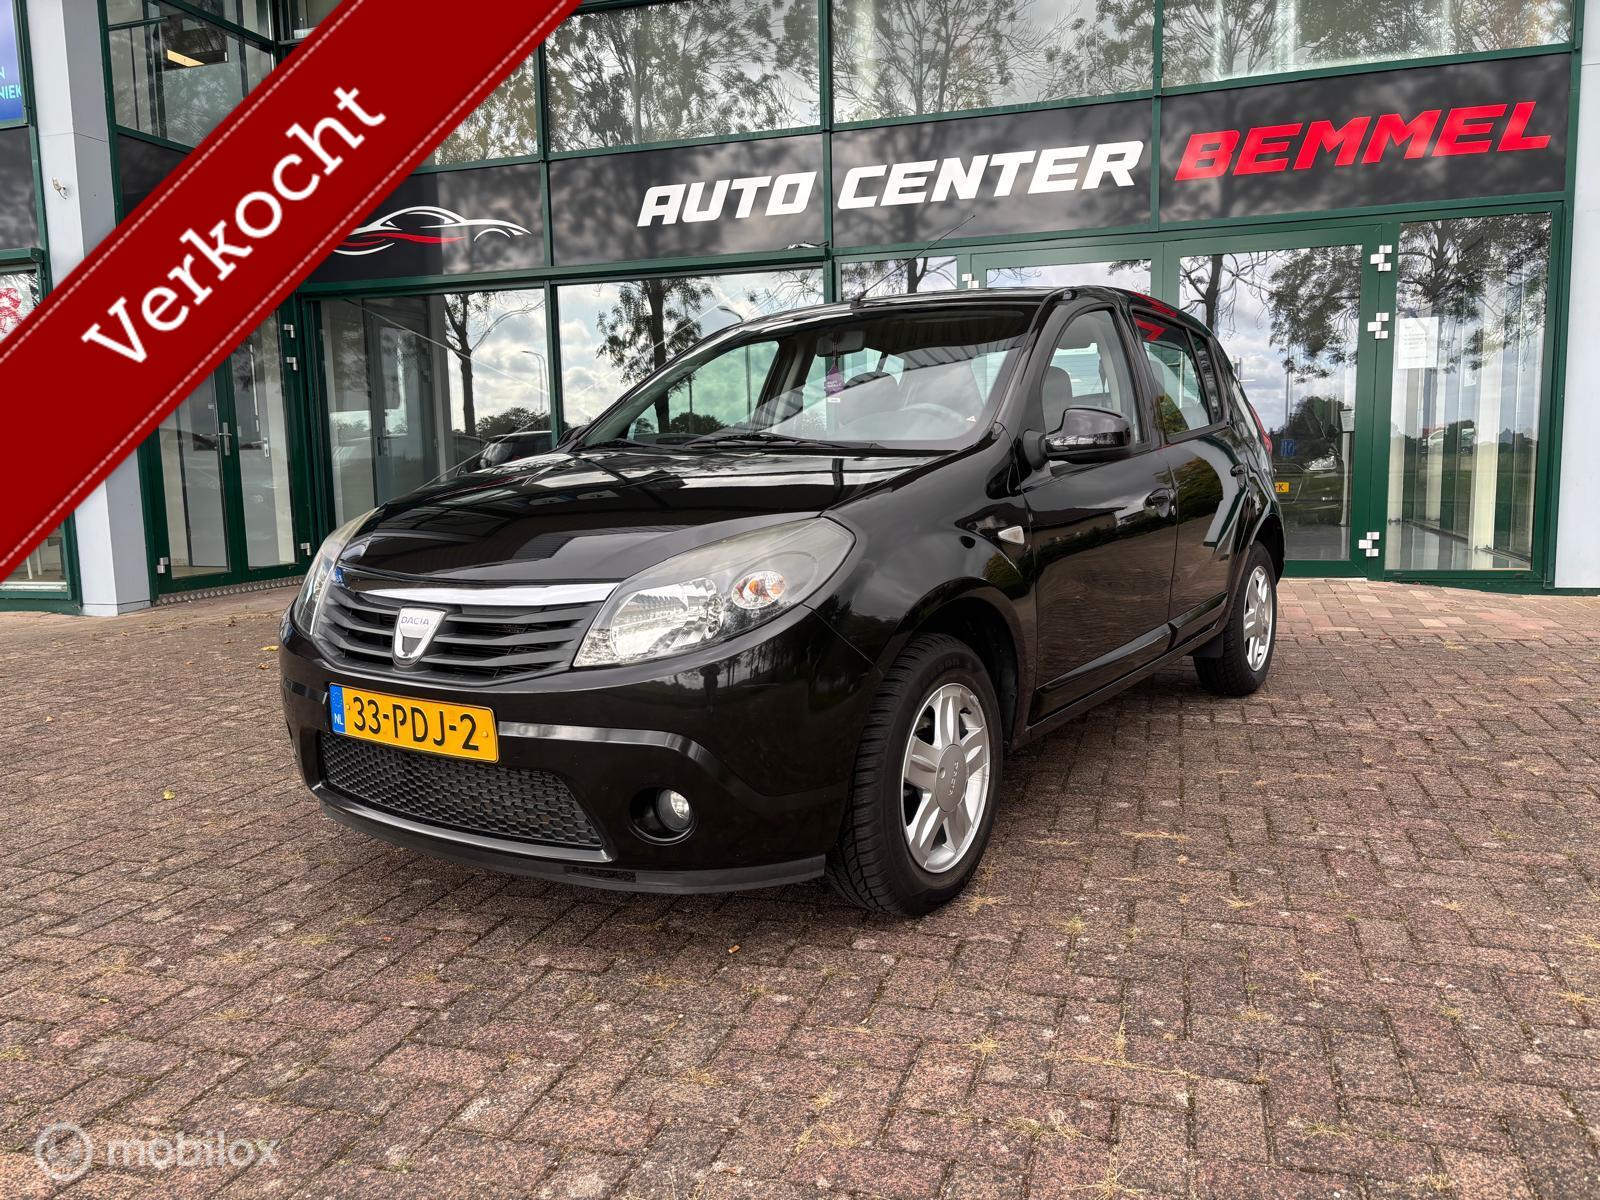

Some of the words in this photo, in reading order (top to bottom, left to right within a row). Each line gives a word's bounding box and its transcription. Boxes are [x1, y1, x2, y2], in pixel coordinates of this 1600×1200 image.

[636, 170, 818, 227] AUTO
[837, 140, 1144, 210] CENTER
[1175, 101, 1551, 181] BEMMEL
[401, 616, 429, 625] DACIA
[334, 714, 344, 726] NL
[353, 696, 479, 751] 33-PDJ-2
